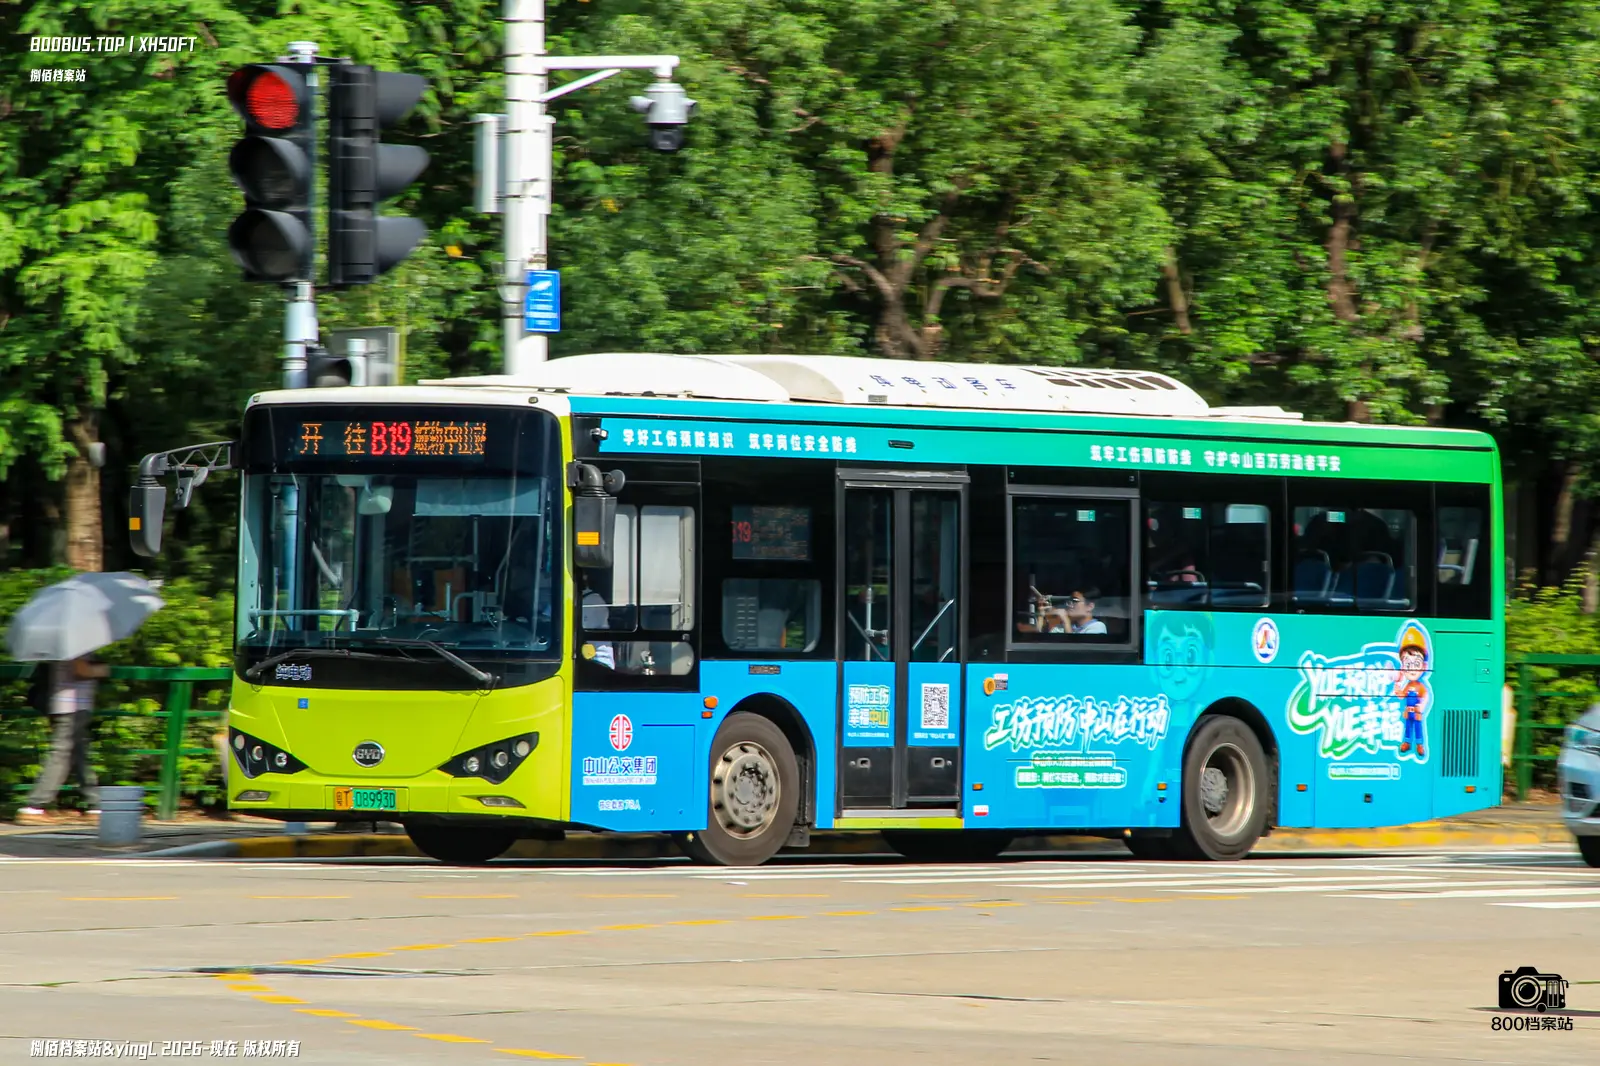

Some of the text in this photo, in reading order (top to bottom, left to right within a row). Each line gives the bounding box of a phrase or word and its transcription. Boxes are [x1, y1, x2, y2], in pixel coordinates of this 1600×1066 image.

[371, 422, 412, 455] B19
[622, 429, 857, 454] 学好工伤预防知识 筑牢岗位安全防线
[1090, 444, 1341, 472] 筑牢工伤预防防线 守护中山百万劳动者平安
[275, 663, 313, 681] 纯电动
[848, 686, 890, 705] 预防工伤
[848, 707, 890, 727] 幸福中山
[1322, 700, 1404, 749] YUE幸福
[355, 748, 381, 760] BYD
[583, 756, 657, 776] 中山公交集团
